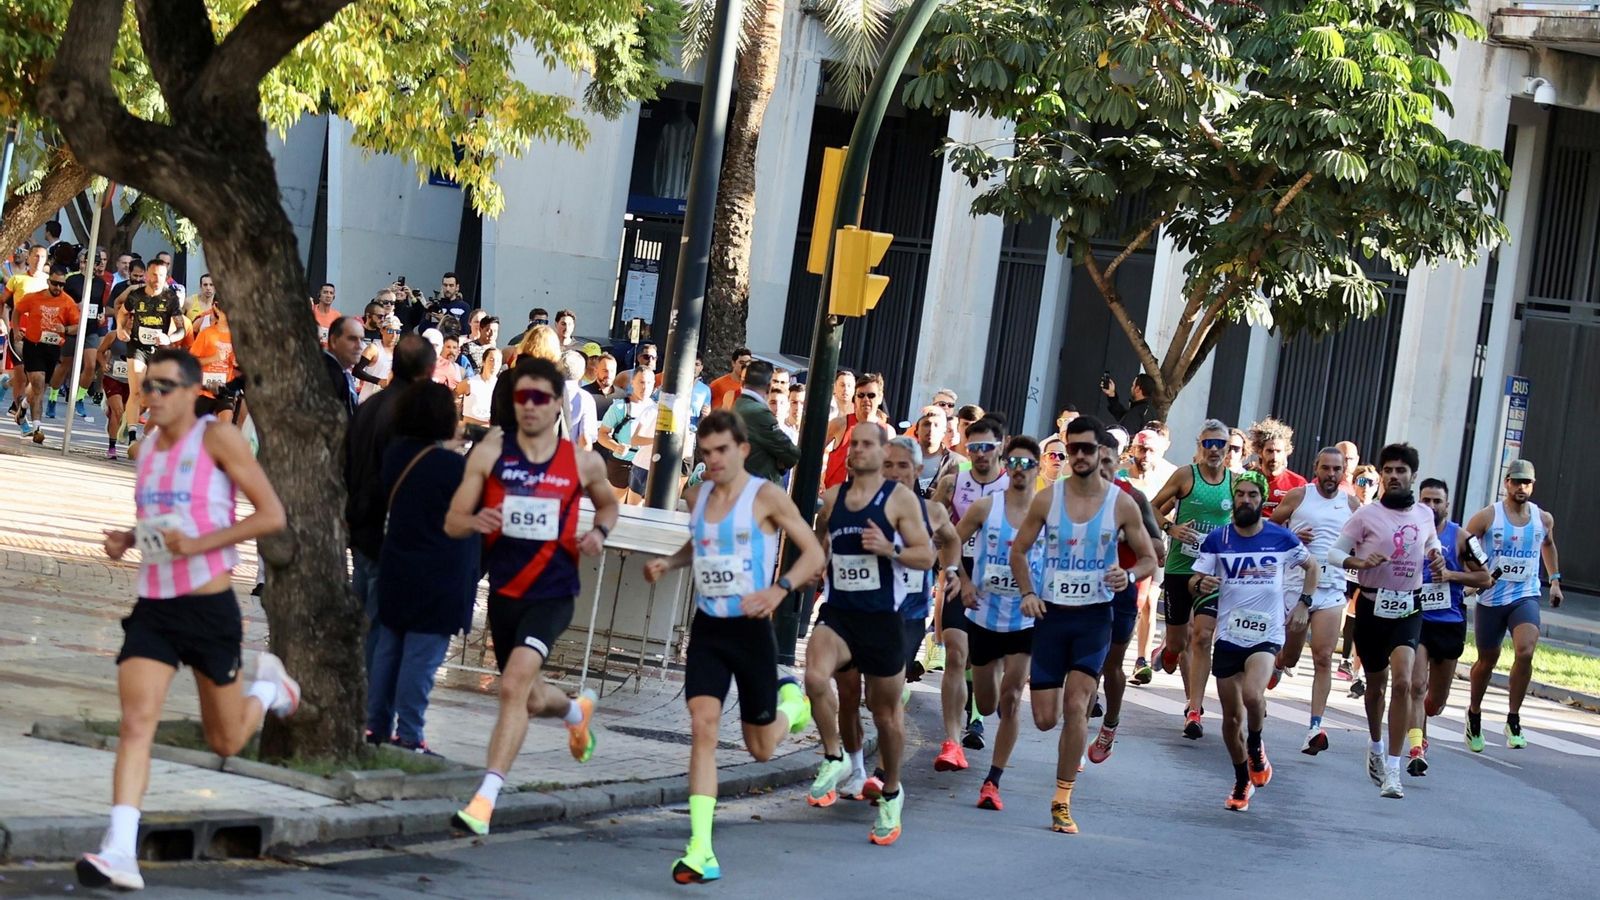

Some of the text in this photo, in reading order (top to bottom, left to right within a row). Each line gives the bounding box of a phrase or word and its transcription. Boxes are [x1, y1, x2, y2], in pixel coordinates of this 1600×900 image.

[1512, 380, 1529, 395] BUS
[510, 511, 547, 526] 694
[1220, 555, 1278, 579] VAS
[1503, 564, 1525, 574] 947
[701, 570, 734, 584] 330
[839, 568, 870, 580] 390
[990, 576, 1020, 588] 312
[1060, 582, 1091, 594] 870
[1420, 592, 1445, 603] 448
[1380, 600, 1408, 611] 324
[1234, 618, 1267, 632] 1029
